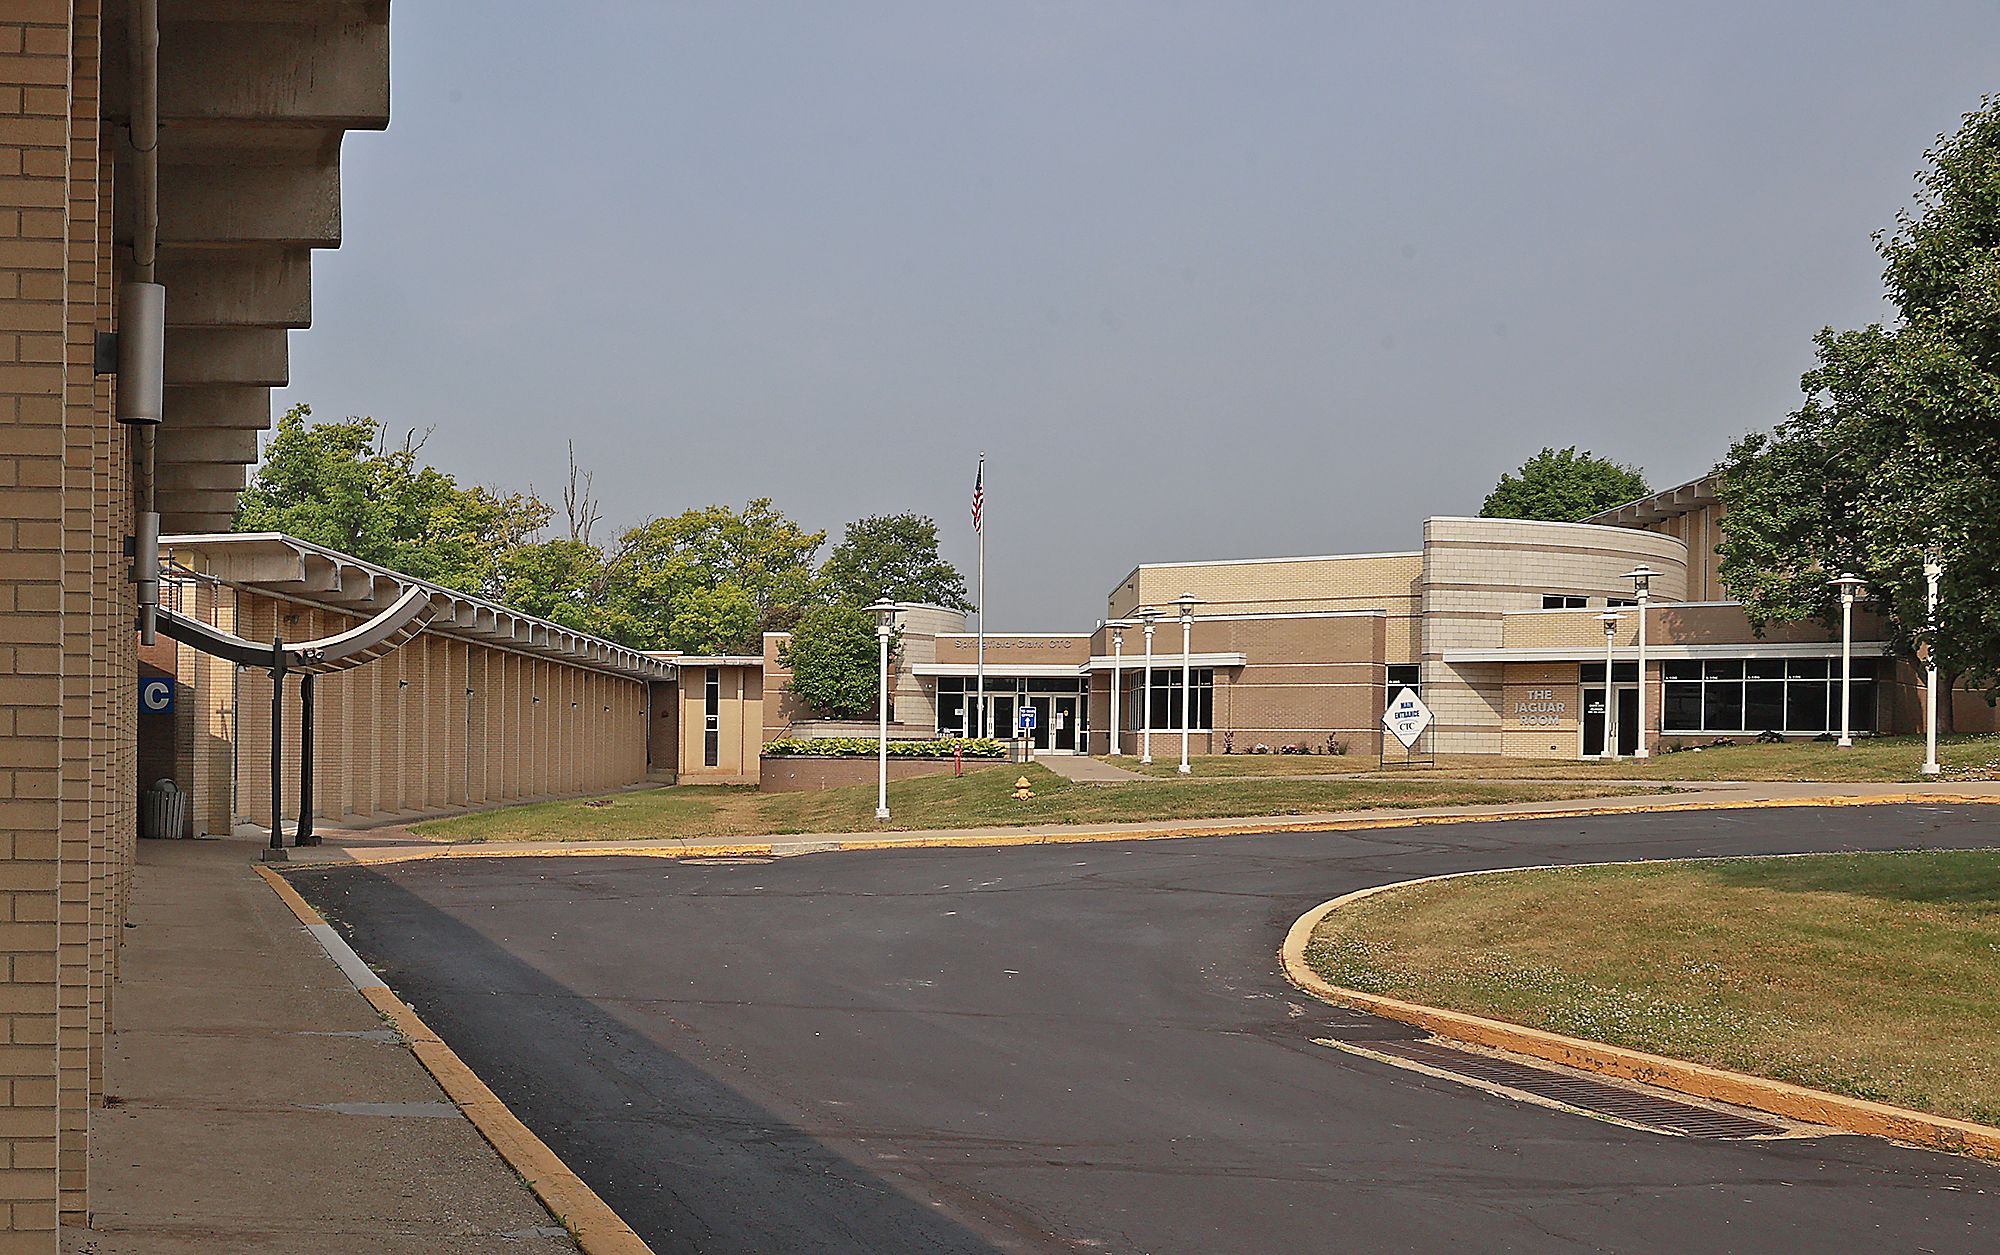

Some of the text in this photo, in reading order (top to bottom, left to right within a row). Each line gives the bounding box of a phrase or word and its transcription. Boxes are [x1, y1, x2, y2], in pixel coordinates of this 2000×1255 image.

[1048, 639, 1072, 649] CTC
[144, 681, 170, 710] C
[1527, 690, 1553, 700] THE
[1400, 701, 1414, 709] MAIN
[1514, 702, 1566, 714] JAGUAR
[1394, 710, 1420, 719] ENTRANCE
[1519, 715, 1560, 726] ROOM
[1399, 722, 1415, 731] CTC
